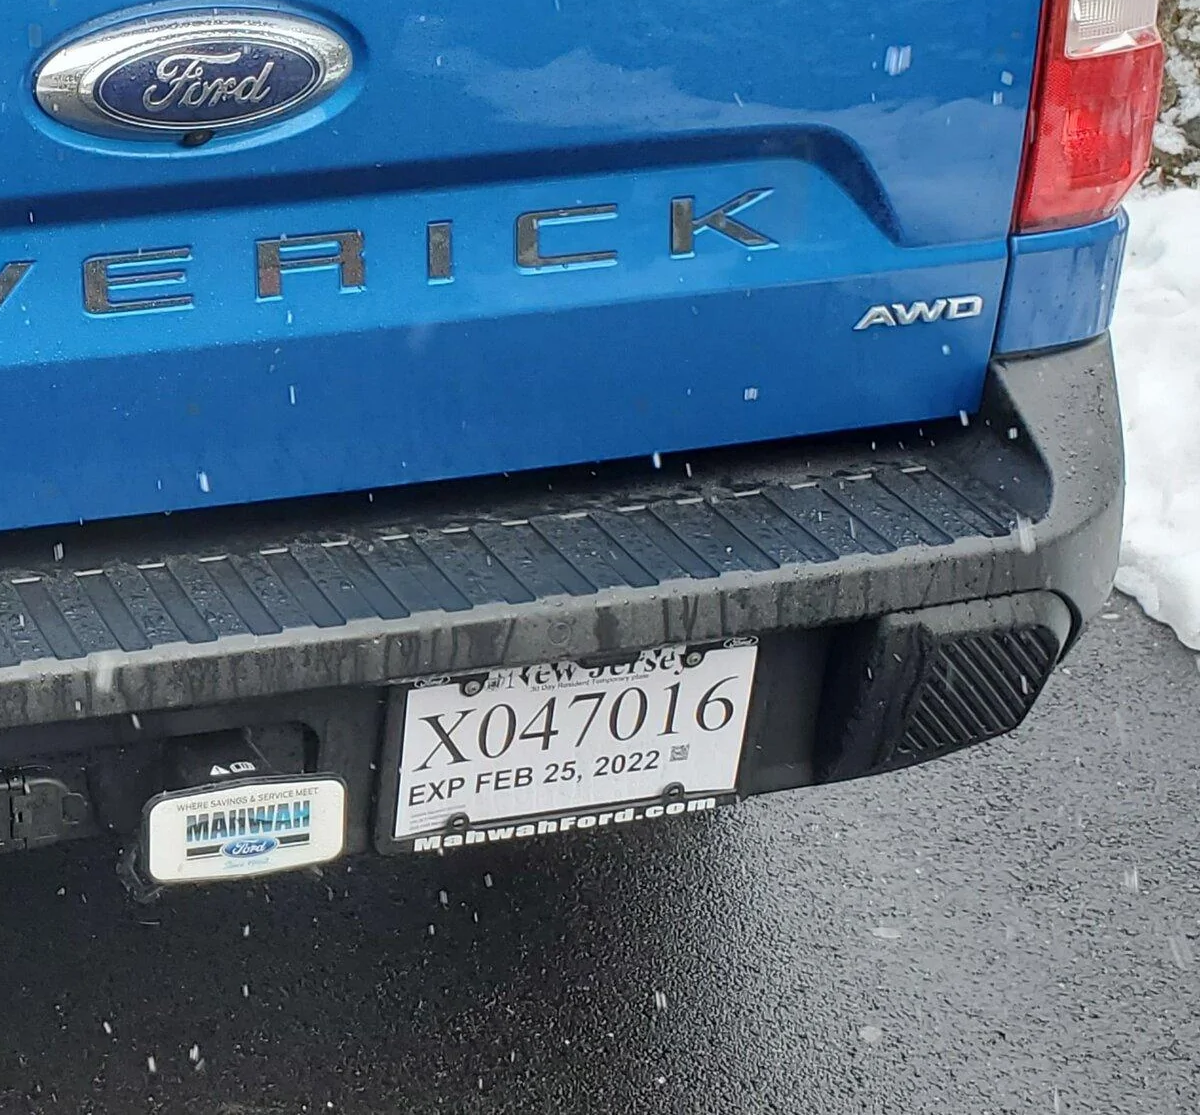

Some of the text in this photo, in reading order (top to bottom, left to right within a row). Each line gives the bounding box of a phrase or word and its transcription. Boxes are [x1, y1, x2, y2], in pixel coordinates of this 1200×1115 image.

[144, 51, 274, 112] Ford
[853, 295, 983, 330] AWD
[412, 675, 738, 772] X047016
[177, 787, 319, 812] WHERE SAVINGS & SERVICE MEET
[408, 750, 660, 807] EXP FEB 25, 2022
[186, 800, 310, 843] MAHWAH
[232, 839, 267, 855] Ford
